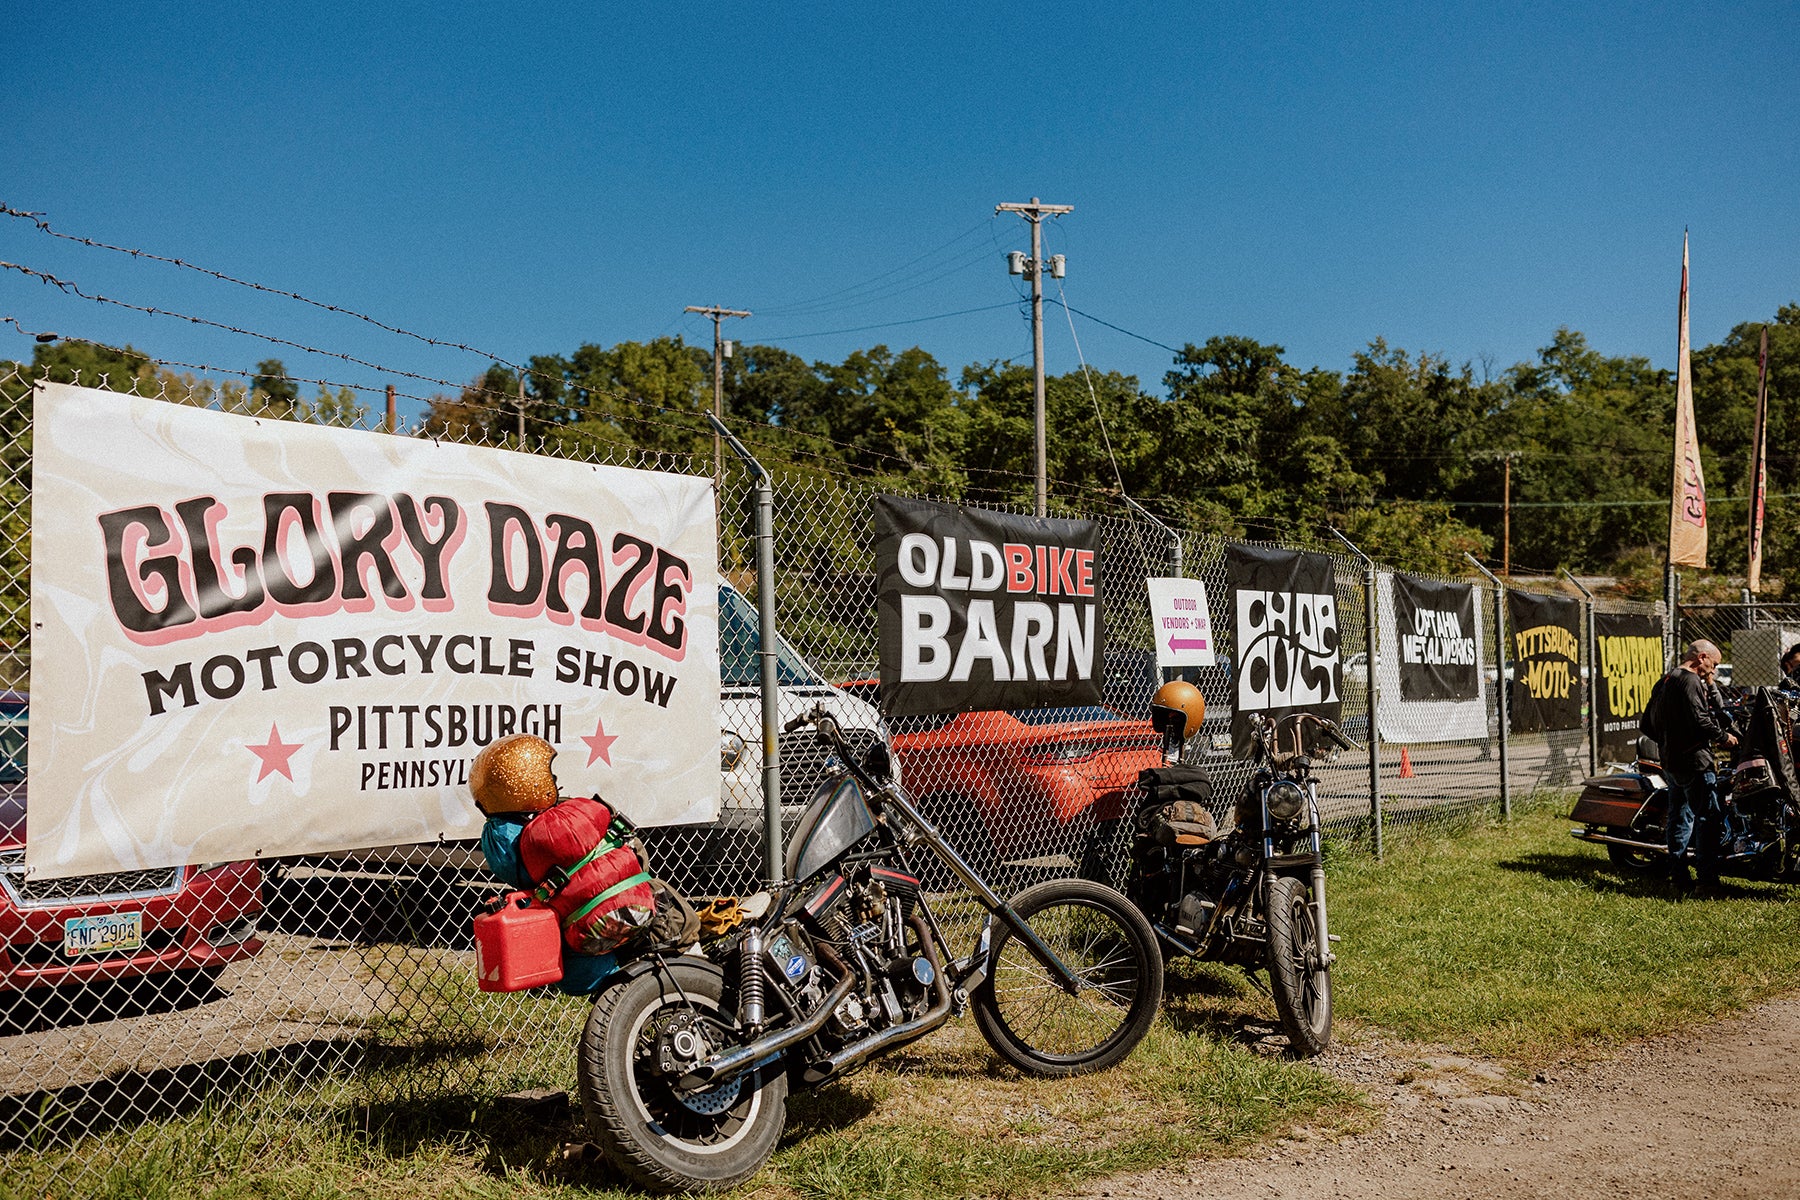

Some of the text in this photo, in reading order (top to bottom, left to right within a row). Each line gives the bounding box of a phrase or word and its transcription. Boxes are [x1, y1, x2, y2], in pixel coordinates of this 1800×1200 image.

[97, 491, 692, 661] GLORY DAZE
[1162, 617, 1189, 629] VENDORS
[1174, 598, 1197, 611] OUTDOOR
[1415, 608, 1462, 638] UPTAHN
[900, 595, 1095, 682] BARN
[1402, 634, 1475, 665] METALWORKS
[1515, 625, 1578, 664] PITTSBURGH
[1598, 635, 1663, 678] LOWBROW
[141, 635, 677, 716] MOTORCYCLE SHOW
[1528, 661, 1569, 699] MOTO
[329, 704, 562, 750] PITTSBURGH
[1604, 721, 1620, 732] MOTO
[361, 759, 473, 790] PENNSYL
